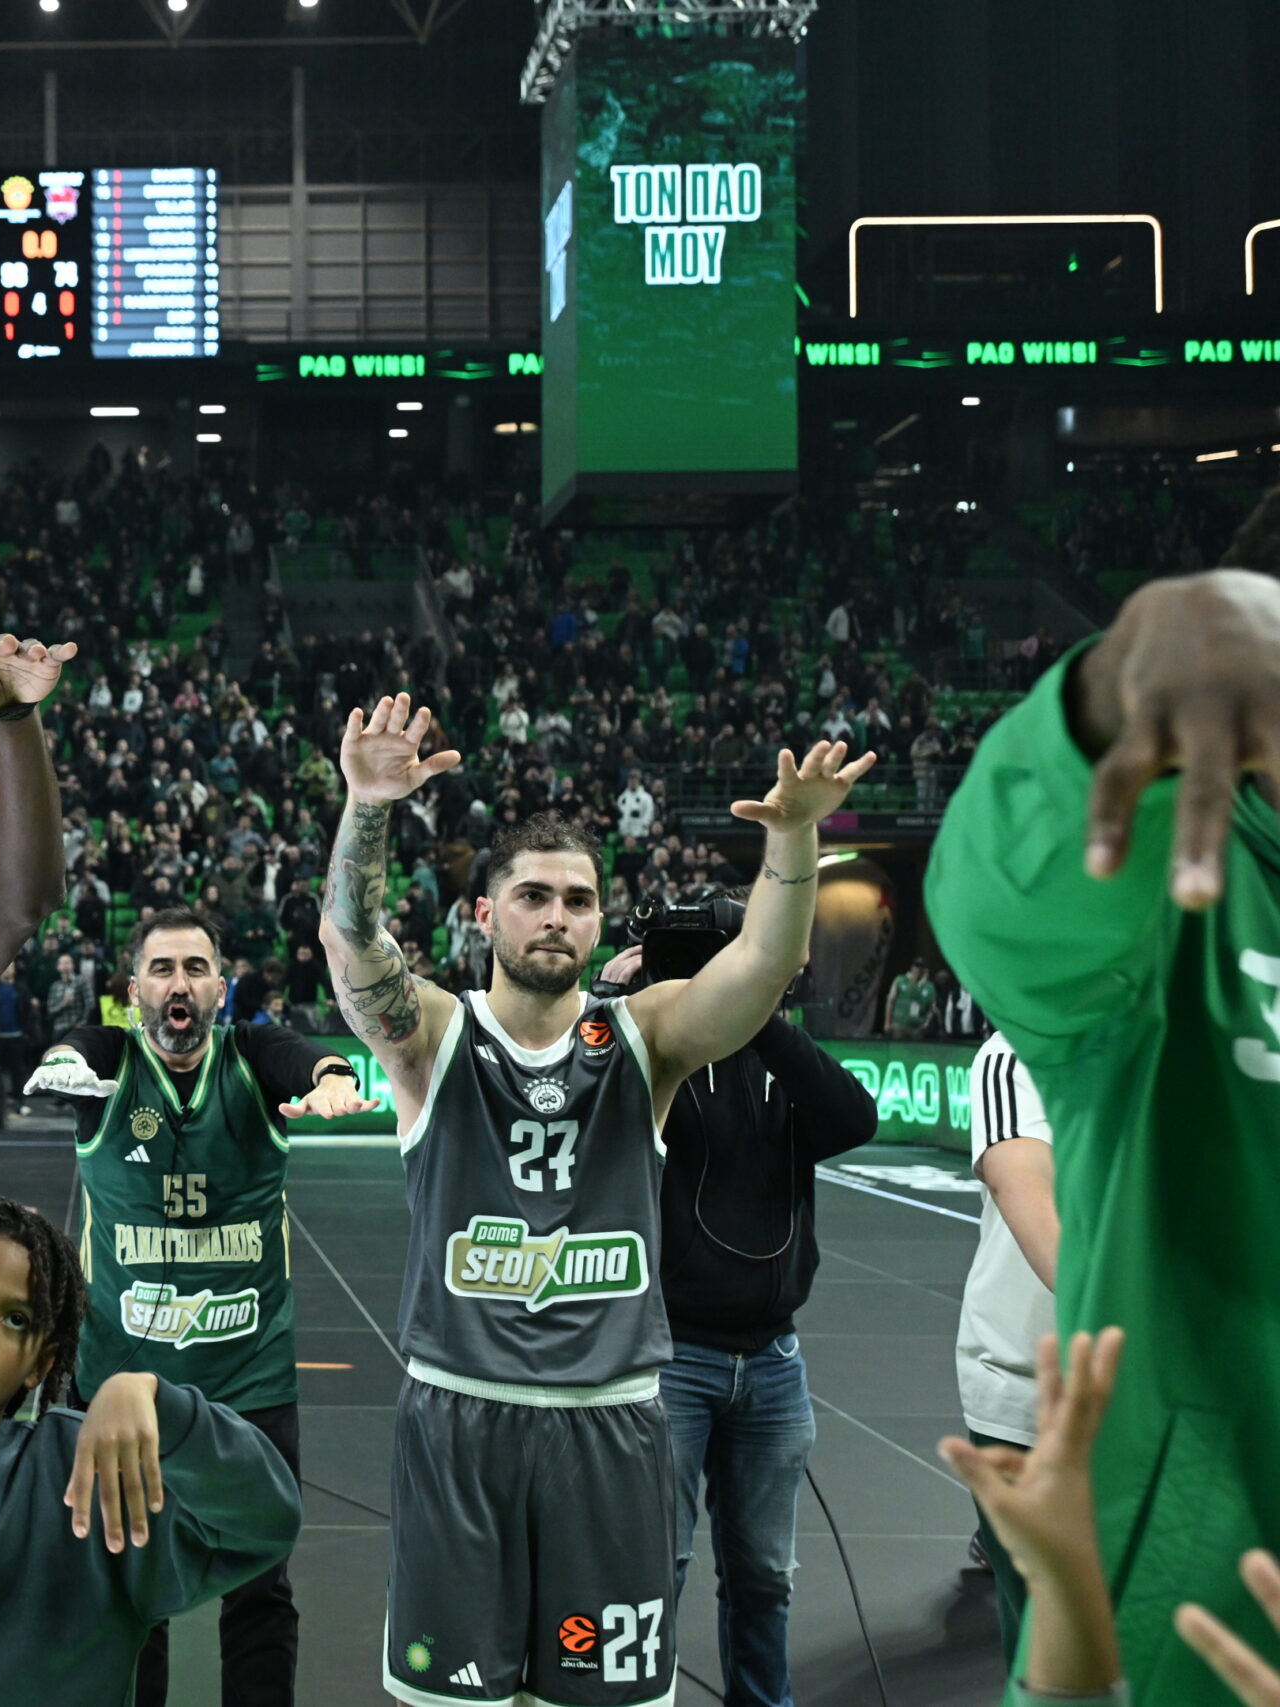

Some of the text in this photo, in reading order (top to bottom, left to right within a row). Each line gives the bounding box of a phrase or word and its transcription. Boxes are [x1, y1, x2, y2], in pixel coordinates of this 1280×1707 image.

[689, 167, 758, 218] ΠΑΟ
[805, 343, 880, 365] WINS!
[967, 341, 1097, 364] PAO WINS!
[1184, 340, 1233, 362] PAO
[299, 355, 425, 378] PAO WINS!
[508, 353, 544, 376] PA
[508, 1118, 580, 1193] 27
[163, 1173, 208, 1219] 55
[115, 1220, 263, 1266] PANATHINAIKOS
[476, 1225, 519, 1243] pame
[135, 1287, 169, 1303] pame
[422, 1633, 434, 1645] bp
[601, 1597, 664, 1683] 27
[561, 1660, 599, 1670] abu dhabi
